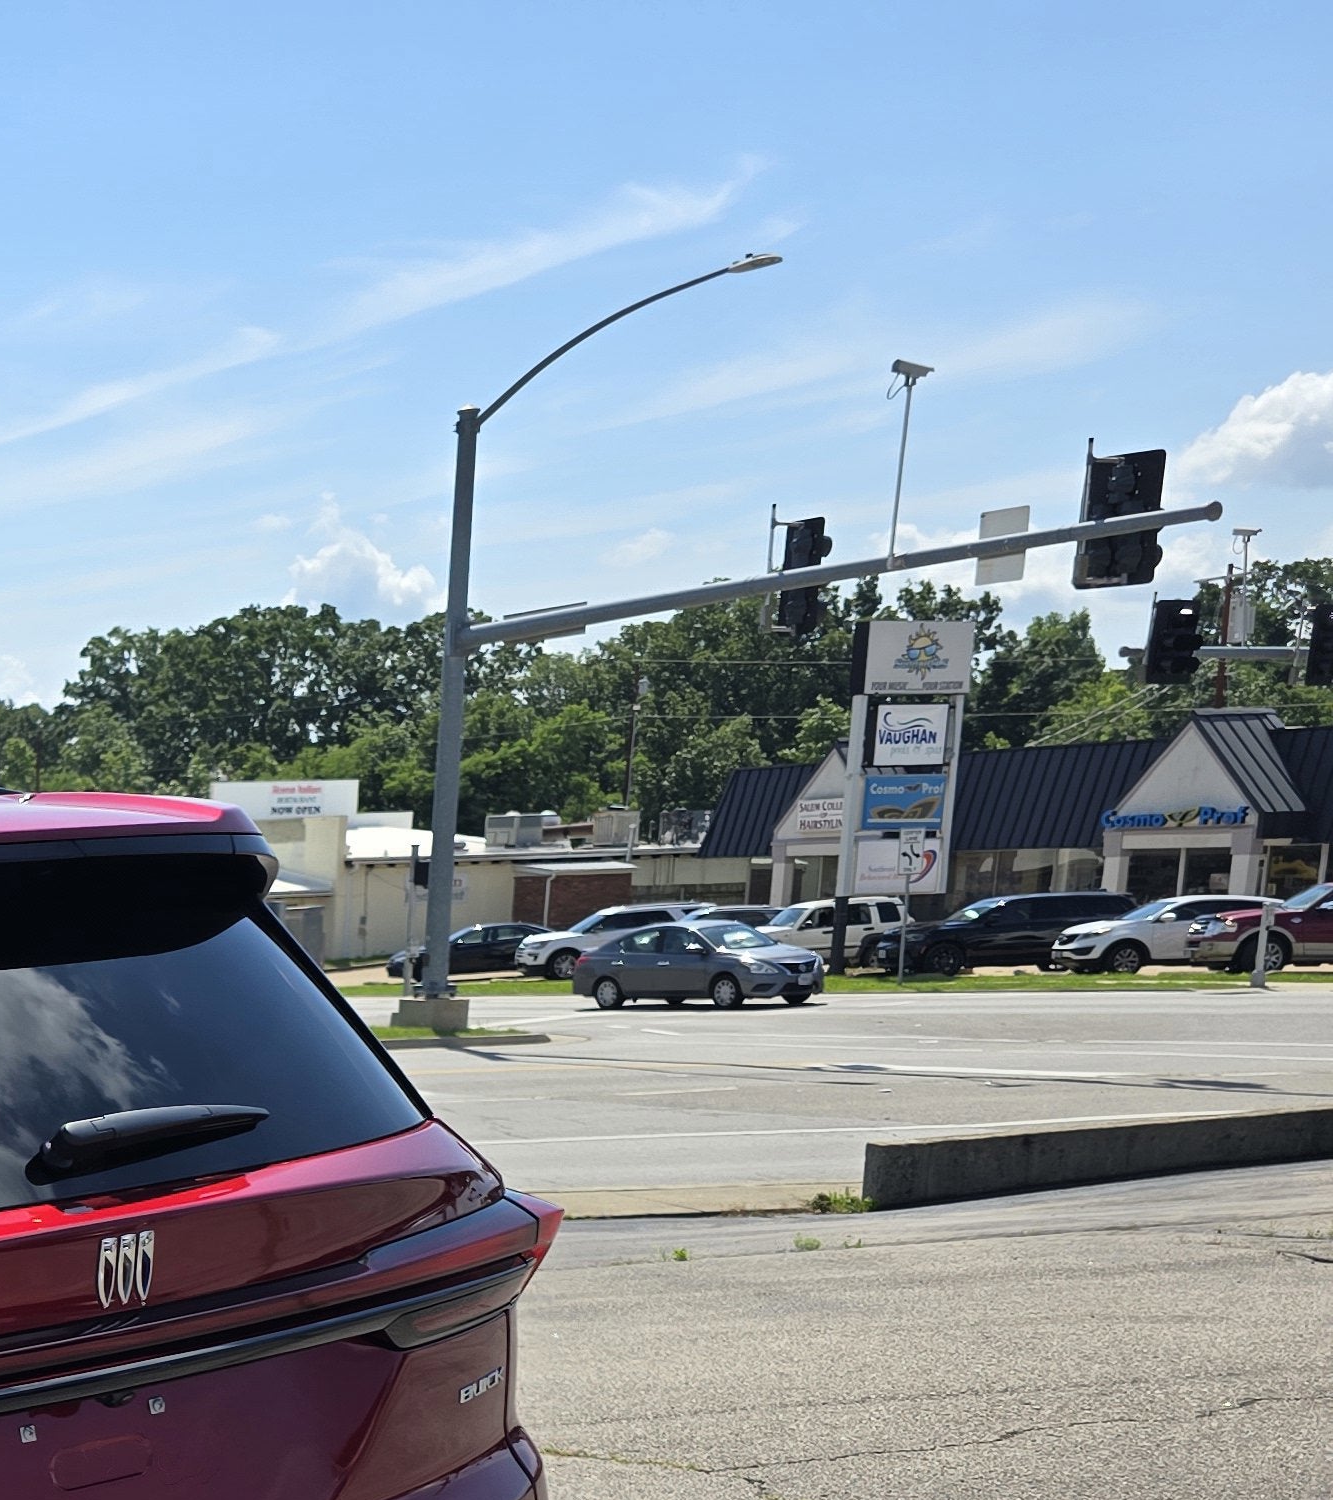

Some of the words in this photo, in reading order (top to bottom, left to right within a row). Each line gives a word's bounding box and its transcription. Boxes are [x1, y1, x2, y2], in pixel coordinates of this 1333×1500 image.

[878, 729, 937, 745] VAUGHAN
[869, 783, 905, 795] Cosmo
[270, 806, 293, 815] NOW
[295, 806, 321, 815] OPEN
[1101, 809, 1167, 828] Cosmo
[1198, 805, 1250, 825] Prof
[460, 1366, 505, 1404] BUICK
